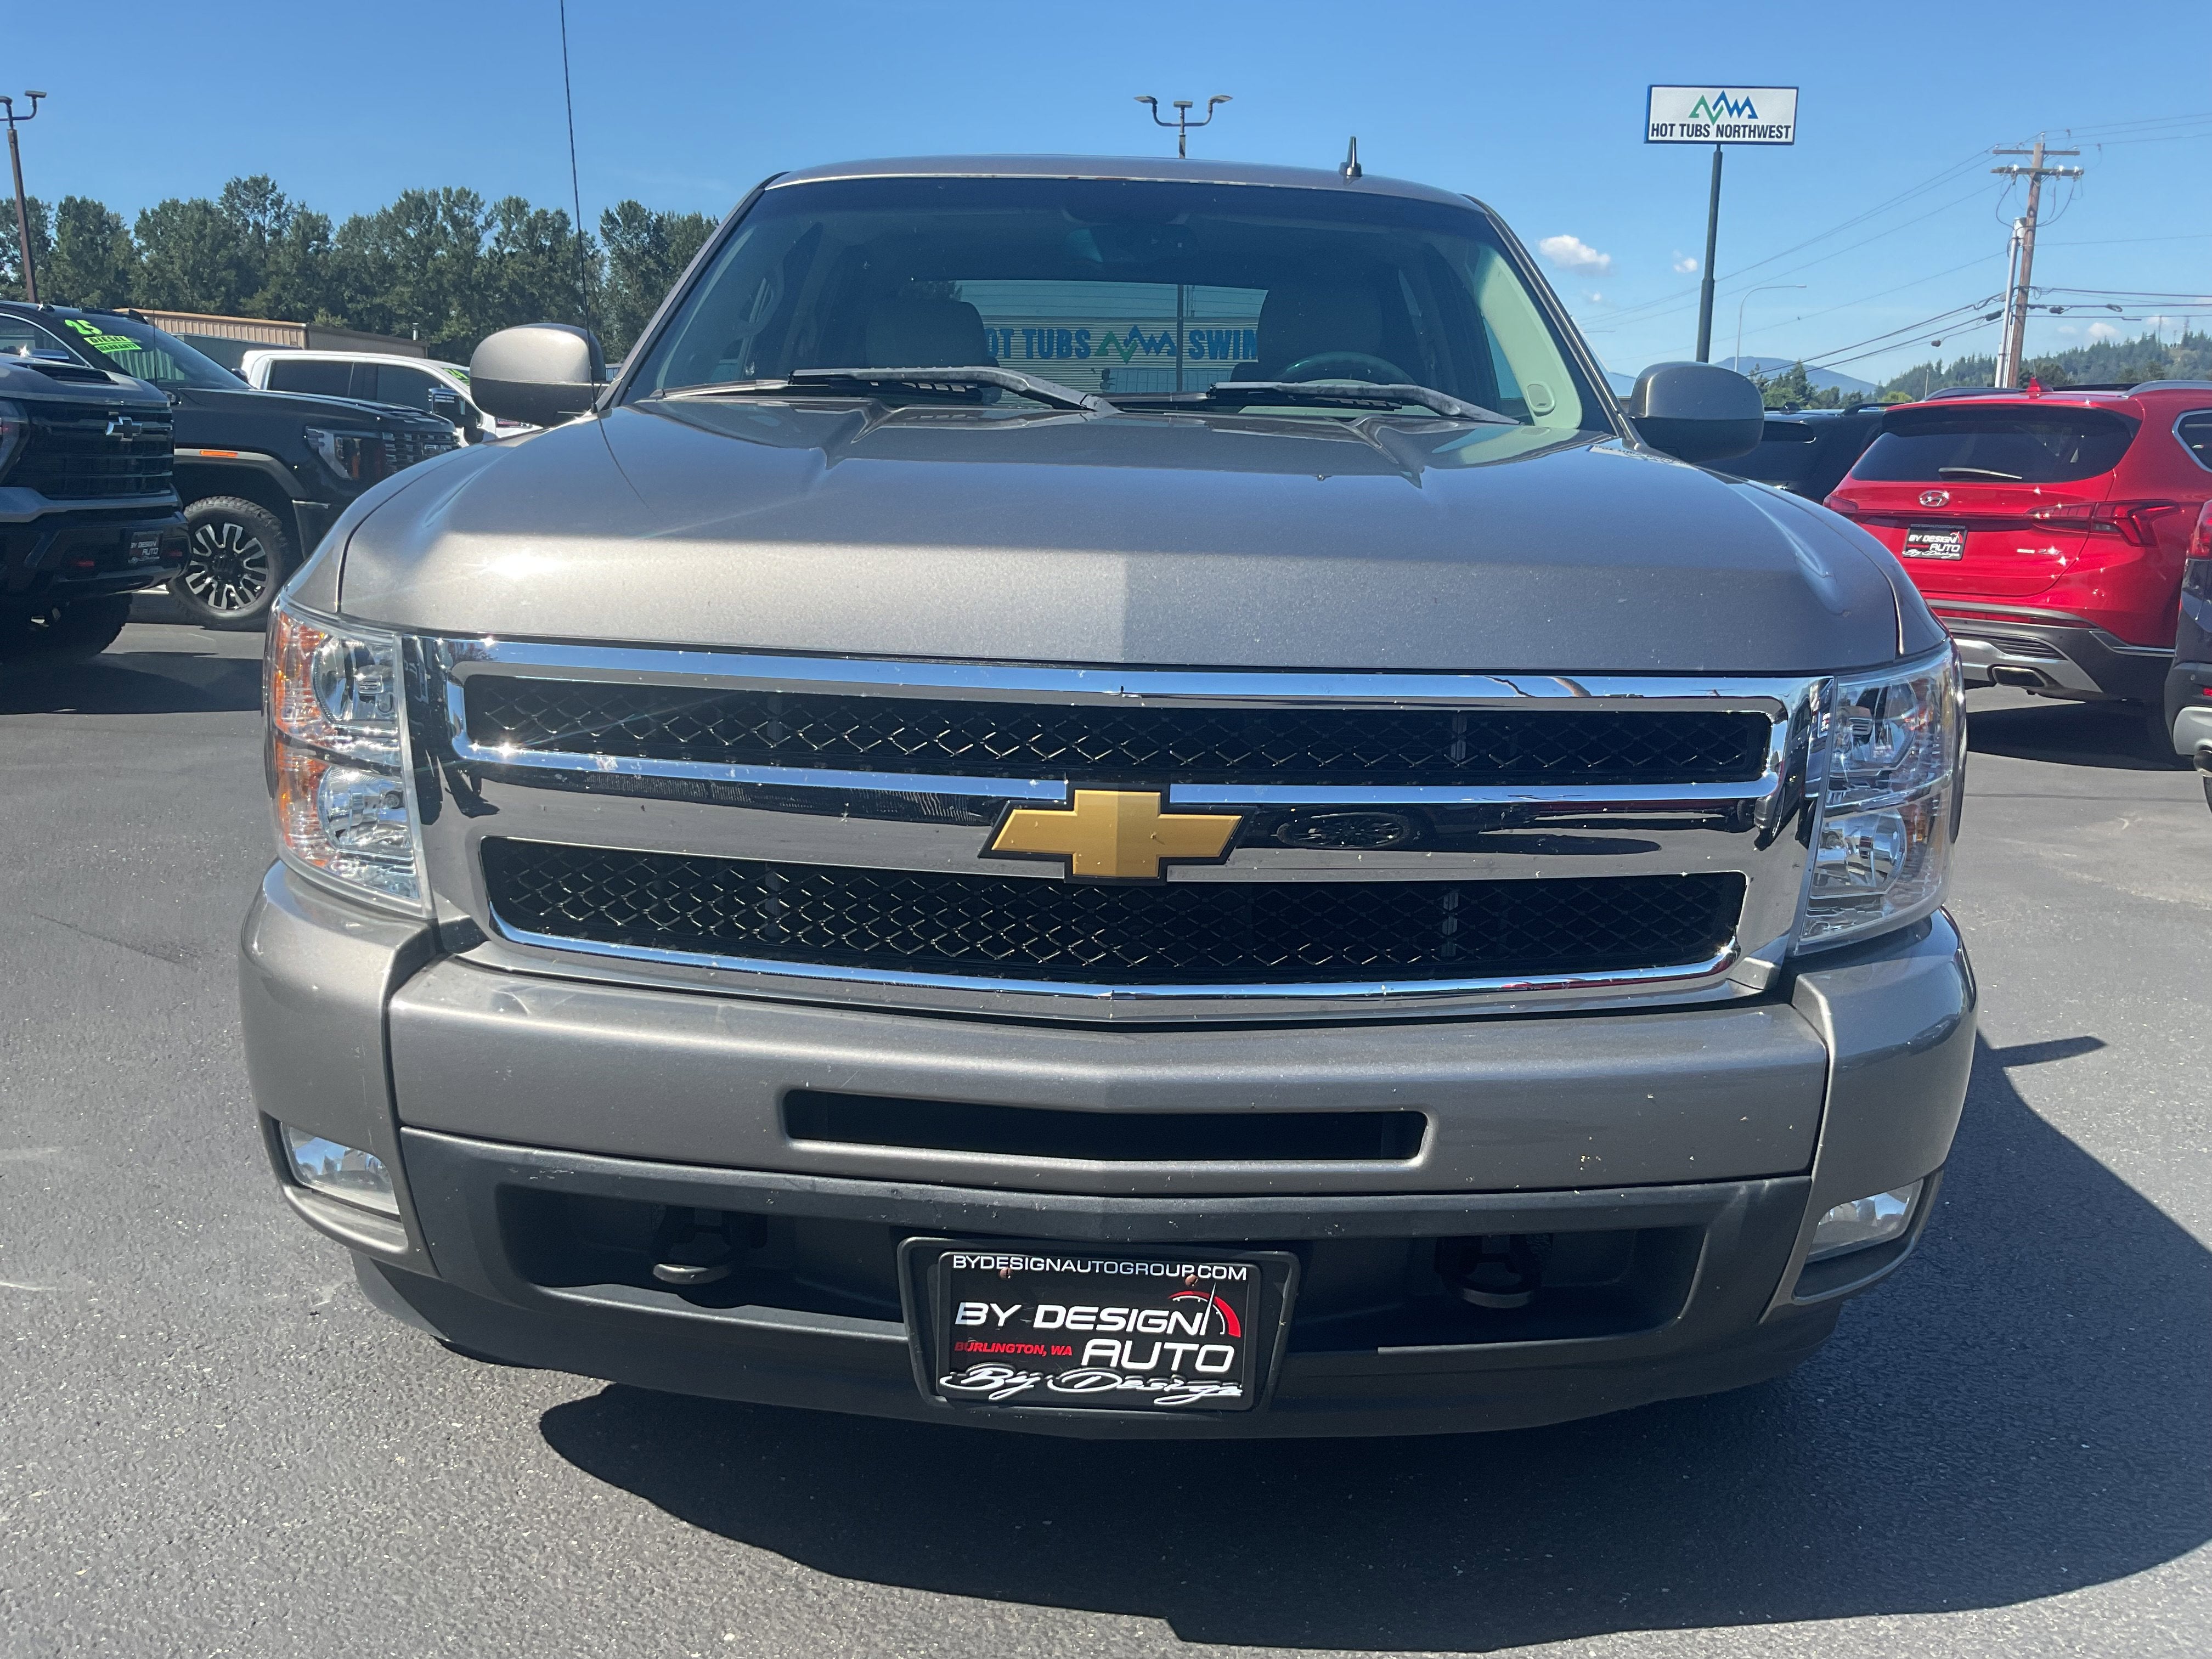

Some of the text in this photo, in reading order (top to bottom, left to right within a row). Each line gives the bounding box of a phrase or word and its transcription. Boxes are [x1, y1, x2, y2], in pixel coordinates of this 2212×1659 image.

[1651, 123, 1791, 139] HOT TUBS NORTHWEST
[64, 319, 103, 335] 25
[985, 329, 1014, 359] OT
[1023, 329, 1091, 359] TUBS
[1922, 535, 1957, 543] DESIGN
[1929, 543, 1961, 552] AUTO
[955, 1302, 1204, 1336] BY DESIGN
[954, 1341, 1073, 1357] BURLINGTON, WA
[1081, 1338, 1235, 1372] AUTO
